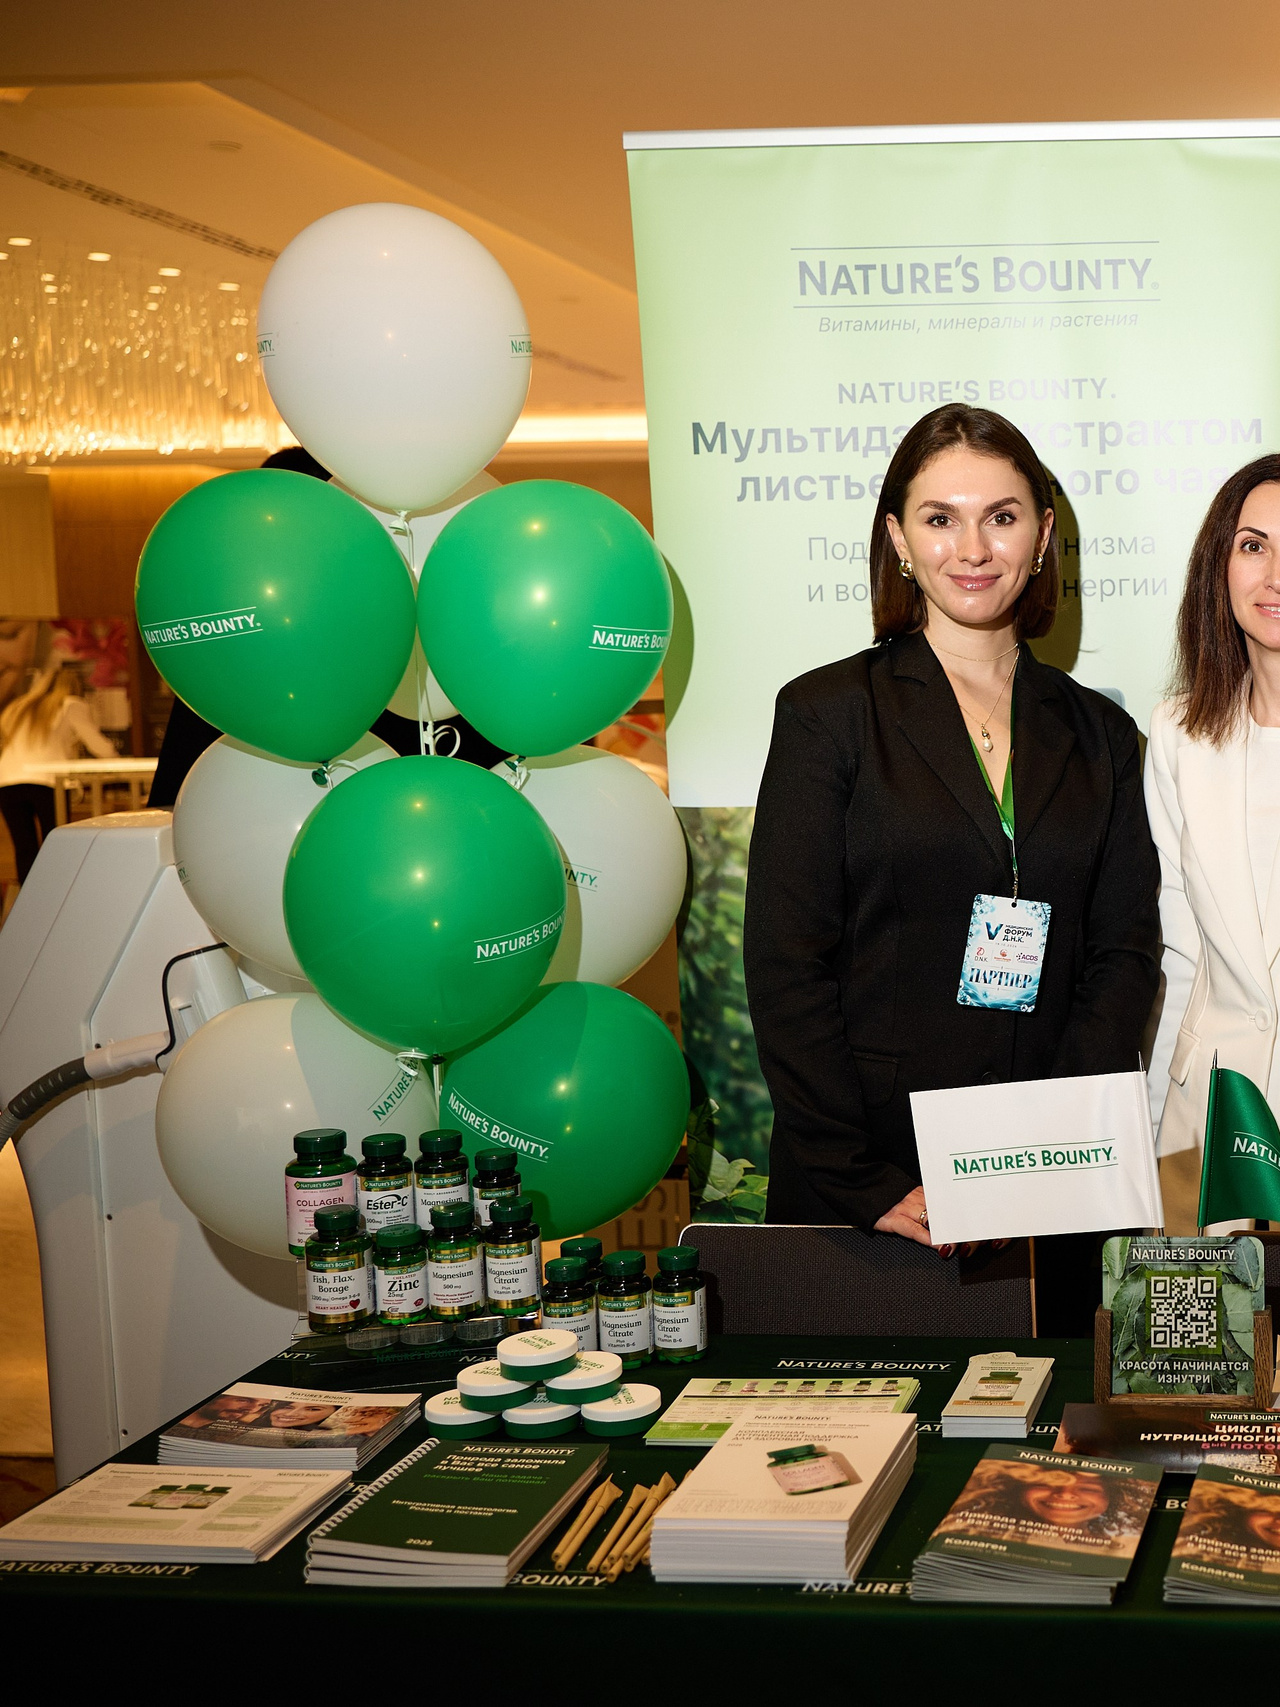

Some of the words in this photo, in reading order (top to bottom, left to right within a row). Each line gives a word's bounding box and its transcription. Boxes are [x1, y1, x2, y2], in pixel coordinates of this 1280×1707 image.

[799, 254, 979, 296] NATURE'S
[818, 316, 921, 333] Витамины,
[928, 314, 1026, 334] минералы
[1033, 316, 1045, 328] и
[1050, 313, 1138, 332] растения
[838, 379, 981, 404] NATURE'S
[692, 421, 911, 463] Мультидэ
[1023, 419, 1262, 454] кстрактом
[737, 474, 884, 502] листье
[808, 584, 823, 602] и
[1063, 577, 1167, 601] нергии
[145, 624, 189, 644] NATURE'S
[592, 630, 649, 648] NATURE'S
[985, 922, 1003, 940] V
[1005, 929, 1033, 937] ФОРУМ
[476, 929, 540, 959] NATURE'S
[449, 1092, 489, 1133] NATURE'S
[953, 1150, 1037, 1175] NATURE'S
[296, 1197, 344, 1207] COLLAGEN
[366, 1196, 408, 1210] Ester-C
[1132, 1248, 1185, 1260] NATURE'S
[313, 1275, 330, 1284] Fish,
[433, 1270, 474, 1281] Magnesium
[319, 1285, 349, 1294] Borage
[388, 1279, 420, 1292] Zinc
[602, 1320, 642, 1332] Magnesium
[608, 1329, 634, 1337] Citrate
[778, 1360, 867, 1371] NATURE'S
[1120, 1361, 1170, 1371] КРАСОТА
[1173, 1361, 1249, 1371] НАЧИНАЕТСЯ
[1158, 1374, 1210, 1384] ИЗНУТРИ
[1215, 1425, 1263, 1435] ЦИКЛ
[463, 1446, 521, 1454] NATURE'S
[446, 1454, 502, 1464] Природа
[1019, 1452, 1079, 1466] NATURE'S
